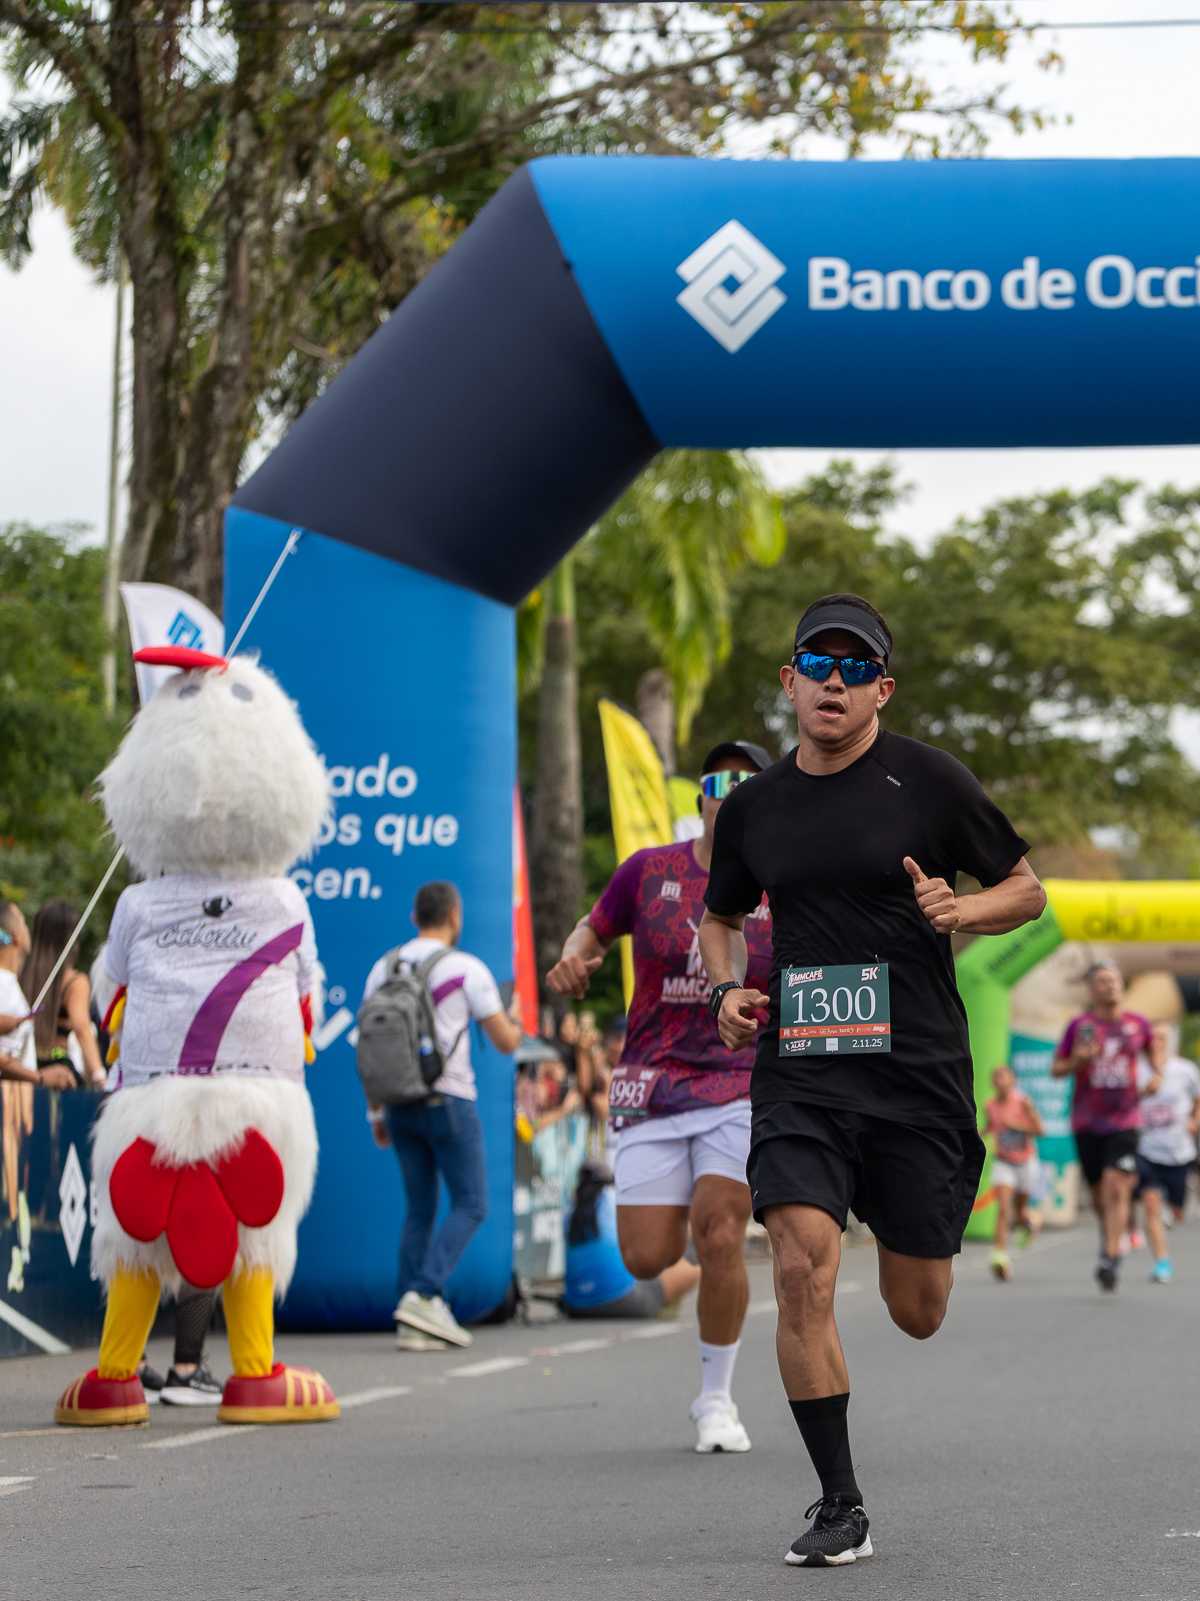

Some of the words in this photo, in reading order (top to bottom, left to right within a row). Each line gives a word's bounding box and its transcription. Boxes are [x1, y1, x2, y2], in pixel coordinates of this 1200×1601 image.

[808, 256, 990, 311] Banco
[1001, 257, 1075, 309] de
[318, 753, 418, 799] ado
[316, 812, 363, 847] os
[374, 812, 459, 855] que
[294, 866, 383, 900] cen.
[662, 977, 713, 997] MMCA
[861, 967, 880, 981] 5K
[792, 986, 876, 1024] 1300
[852, 1038, 883, 1048] 2.11.25
